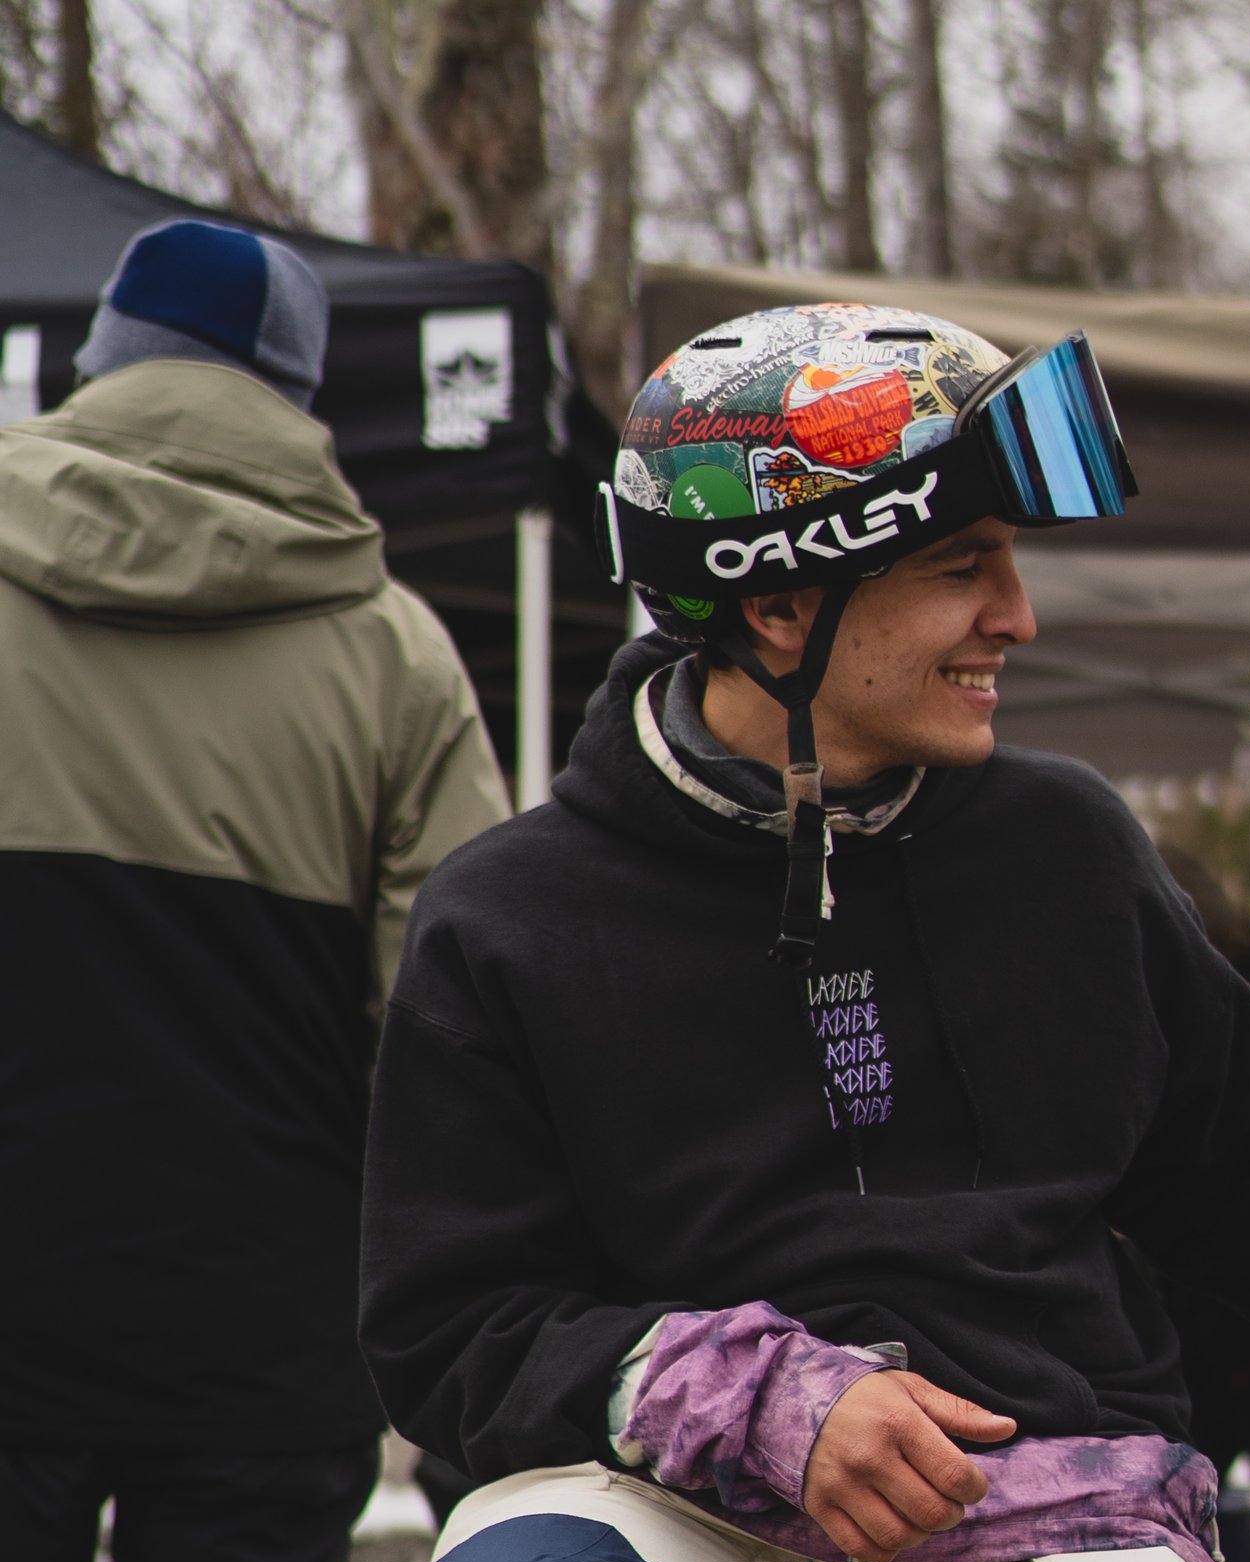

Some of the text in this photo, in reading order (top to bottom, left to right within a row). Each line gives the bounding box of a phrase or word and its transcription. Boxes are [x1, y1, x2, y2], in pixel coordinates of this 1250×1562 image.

[818, 341, 897, 362] NASHVILLE
[810, 409, 905, 454] NATIONAL PARK
[841, 434, 888, 464] 1930
[704, 470, 939, 580] OAKLEY
